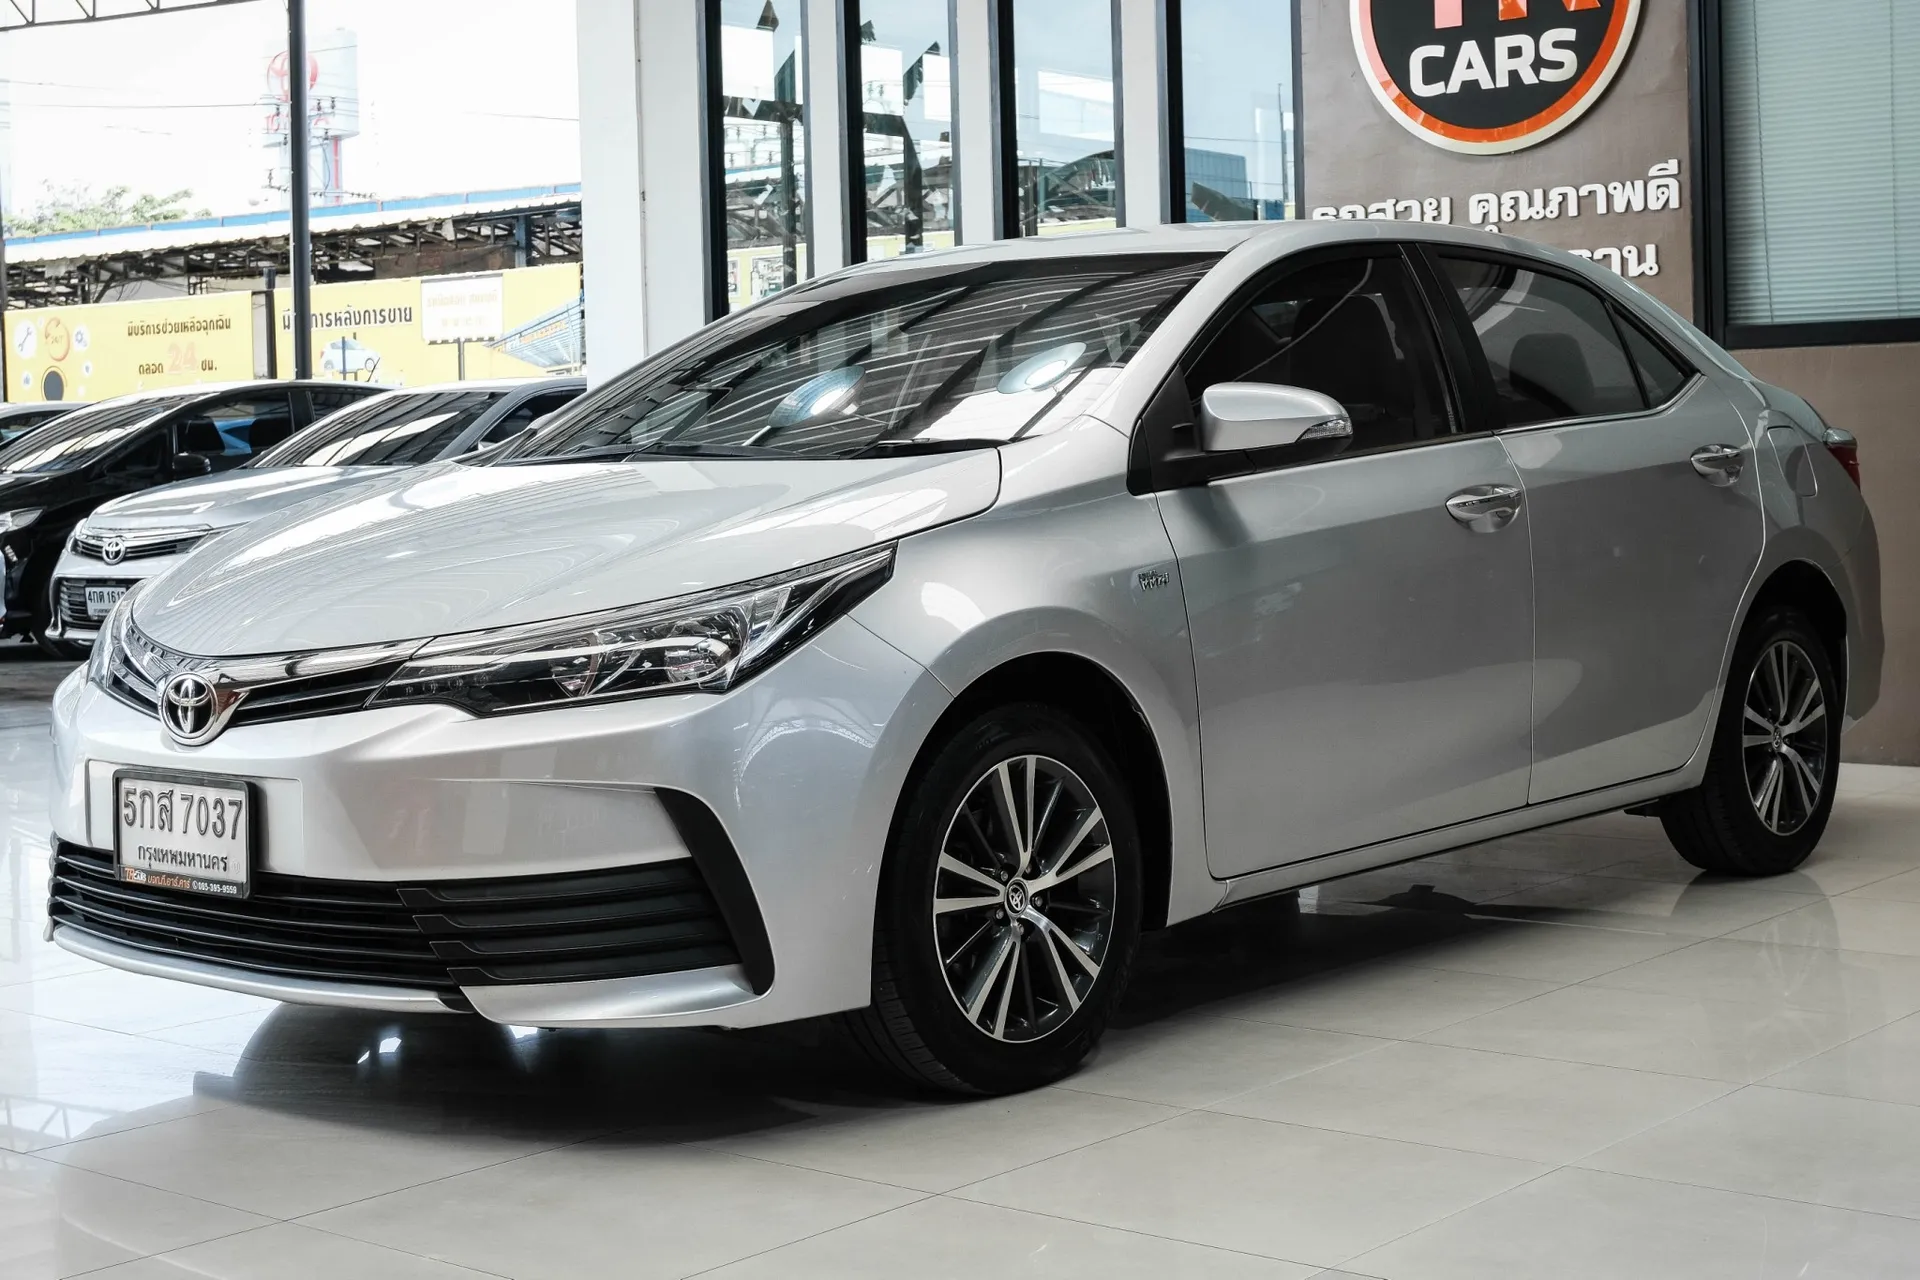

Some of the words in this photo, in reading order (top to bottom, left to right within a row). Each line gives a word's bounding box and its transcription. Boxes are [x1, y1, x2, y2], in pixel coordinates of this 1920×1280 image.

[1409, 28, 1578, 97] CARS
[1468, 158, 1681, 233] คุณภาพดี
[138, 362, 164, 375] ตลอด
[167, 341, 198, 374] 24
[123, 787, 174, 832] 5กส
[180, 793, 243, 840] 7037
[138, 845, 228, 872] กรุงเทพมหานคร
